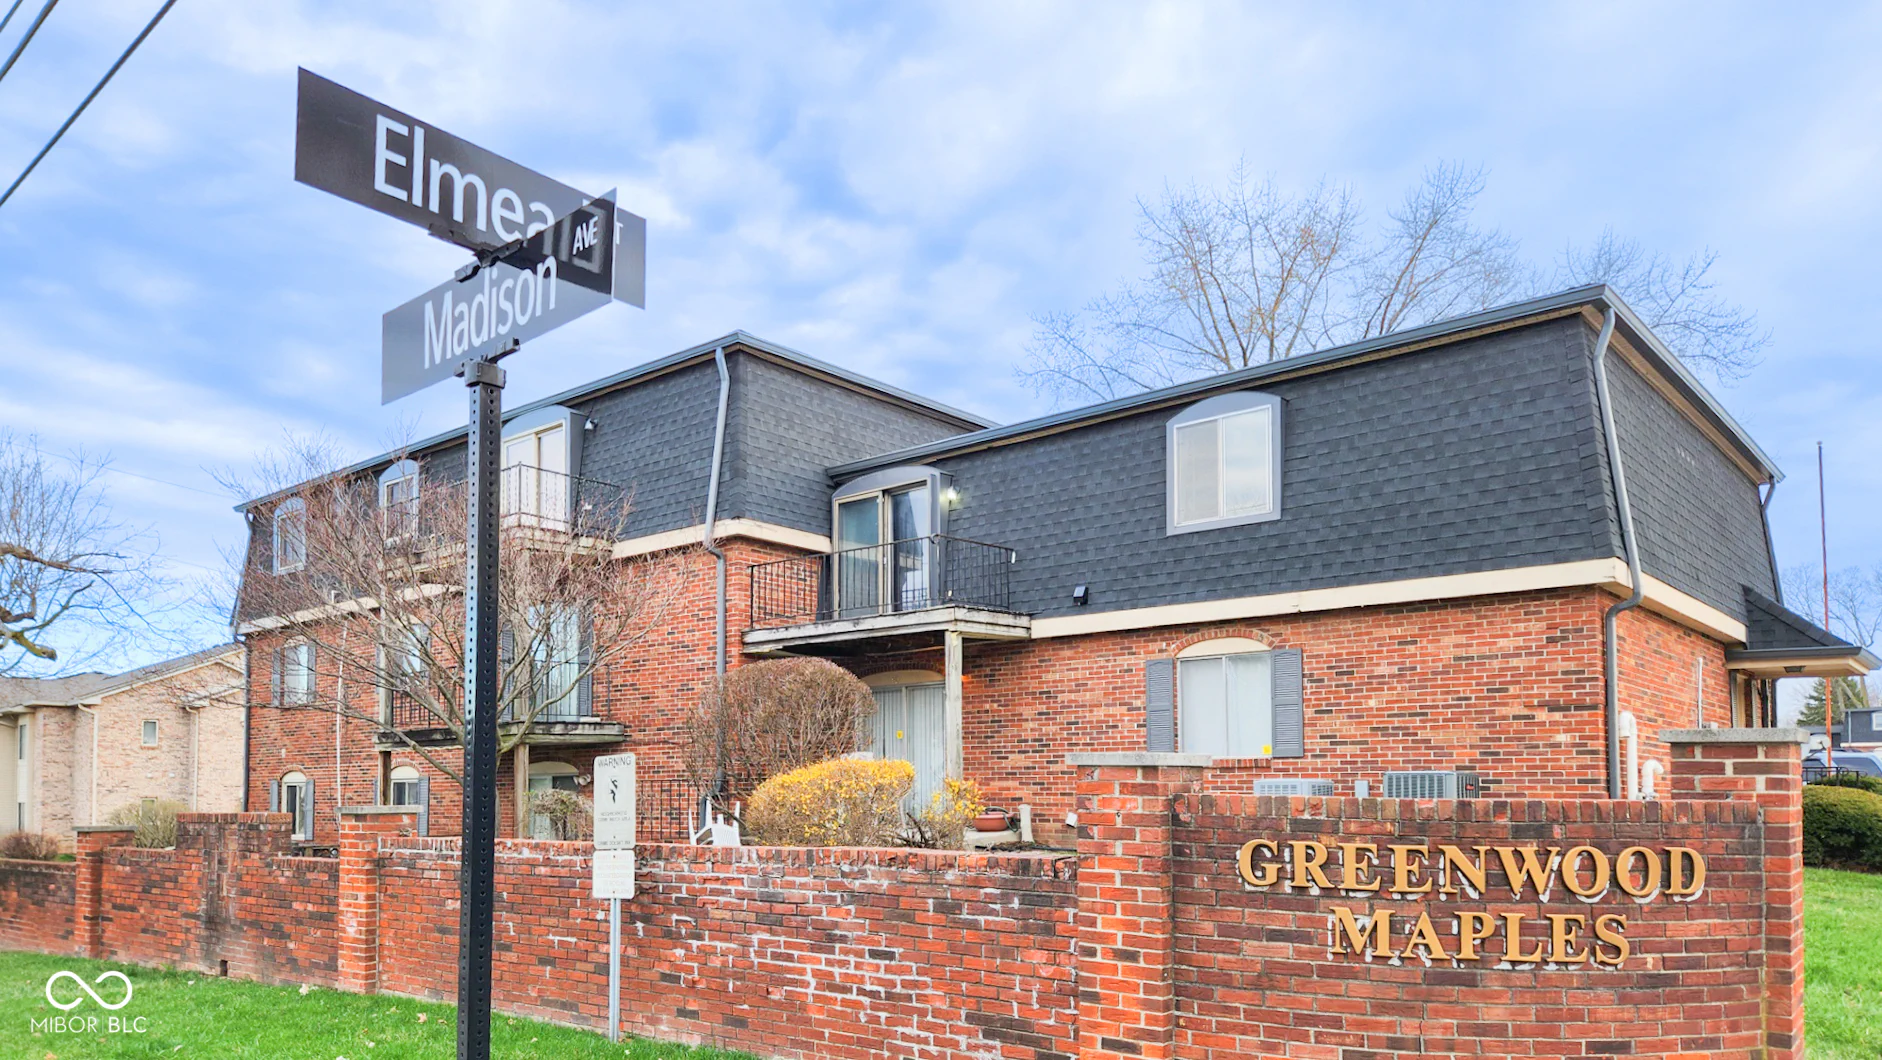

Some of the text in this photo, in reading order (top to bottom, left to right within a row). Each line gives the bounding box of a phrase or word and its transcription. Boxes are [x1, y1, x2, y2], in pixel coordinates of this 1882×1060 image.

[374, 113, 592, 243] Elmea
[423, 216, 599, 370] Madison AVE
[597, 756, 632, 768] WARNING
[1238, 838, 1707, 898] GREENWOOD
[1329, 906, 1631, 966] MAPLES
